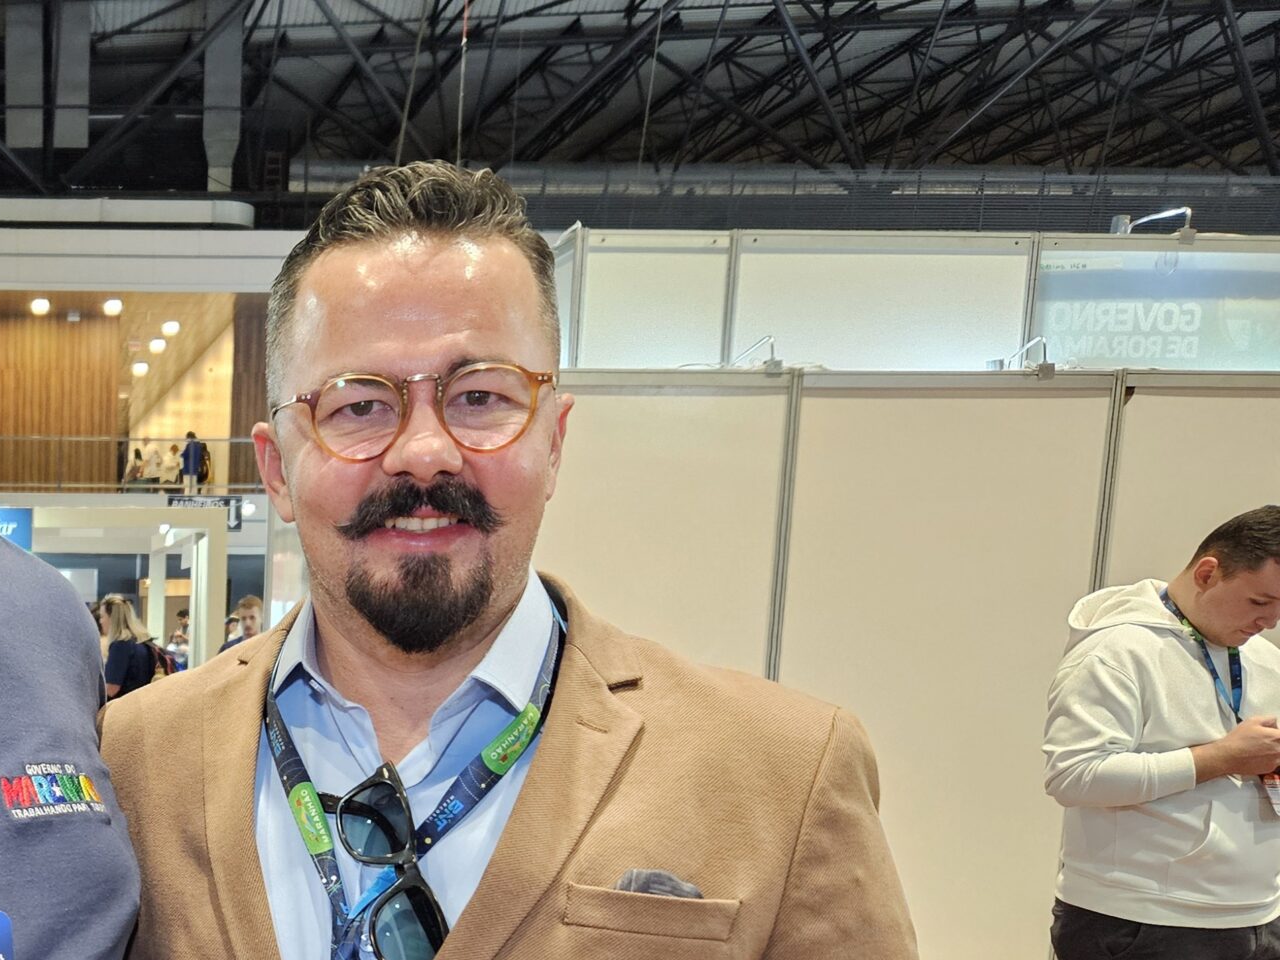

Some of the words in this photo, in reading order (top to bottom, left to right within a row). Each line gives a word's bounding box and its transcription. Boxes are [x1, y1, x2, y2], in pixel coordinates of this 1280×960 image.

[25, 763, 63, 775] GOVERNO
[11, 803, 73, 819] TRABALHANDO
[434, 799, 464, 832] BNT
